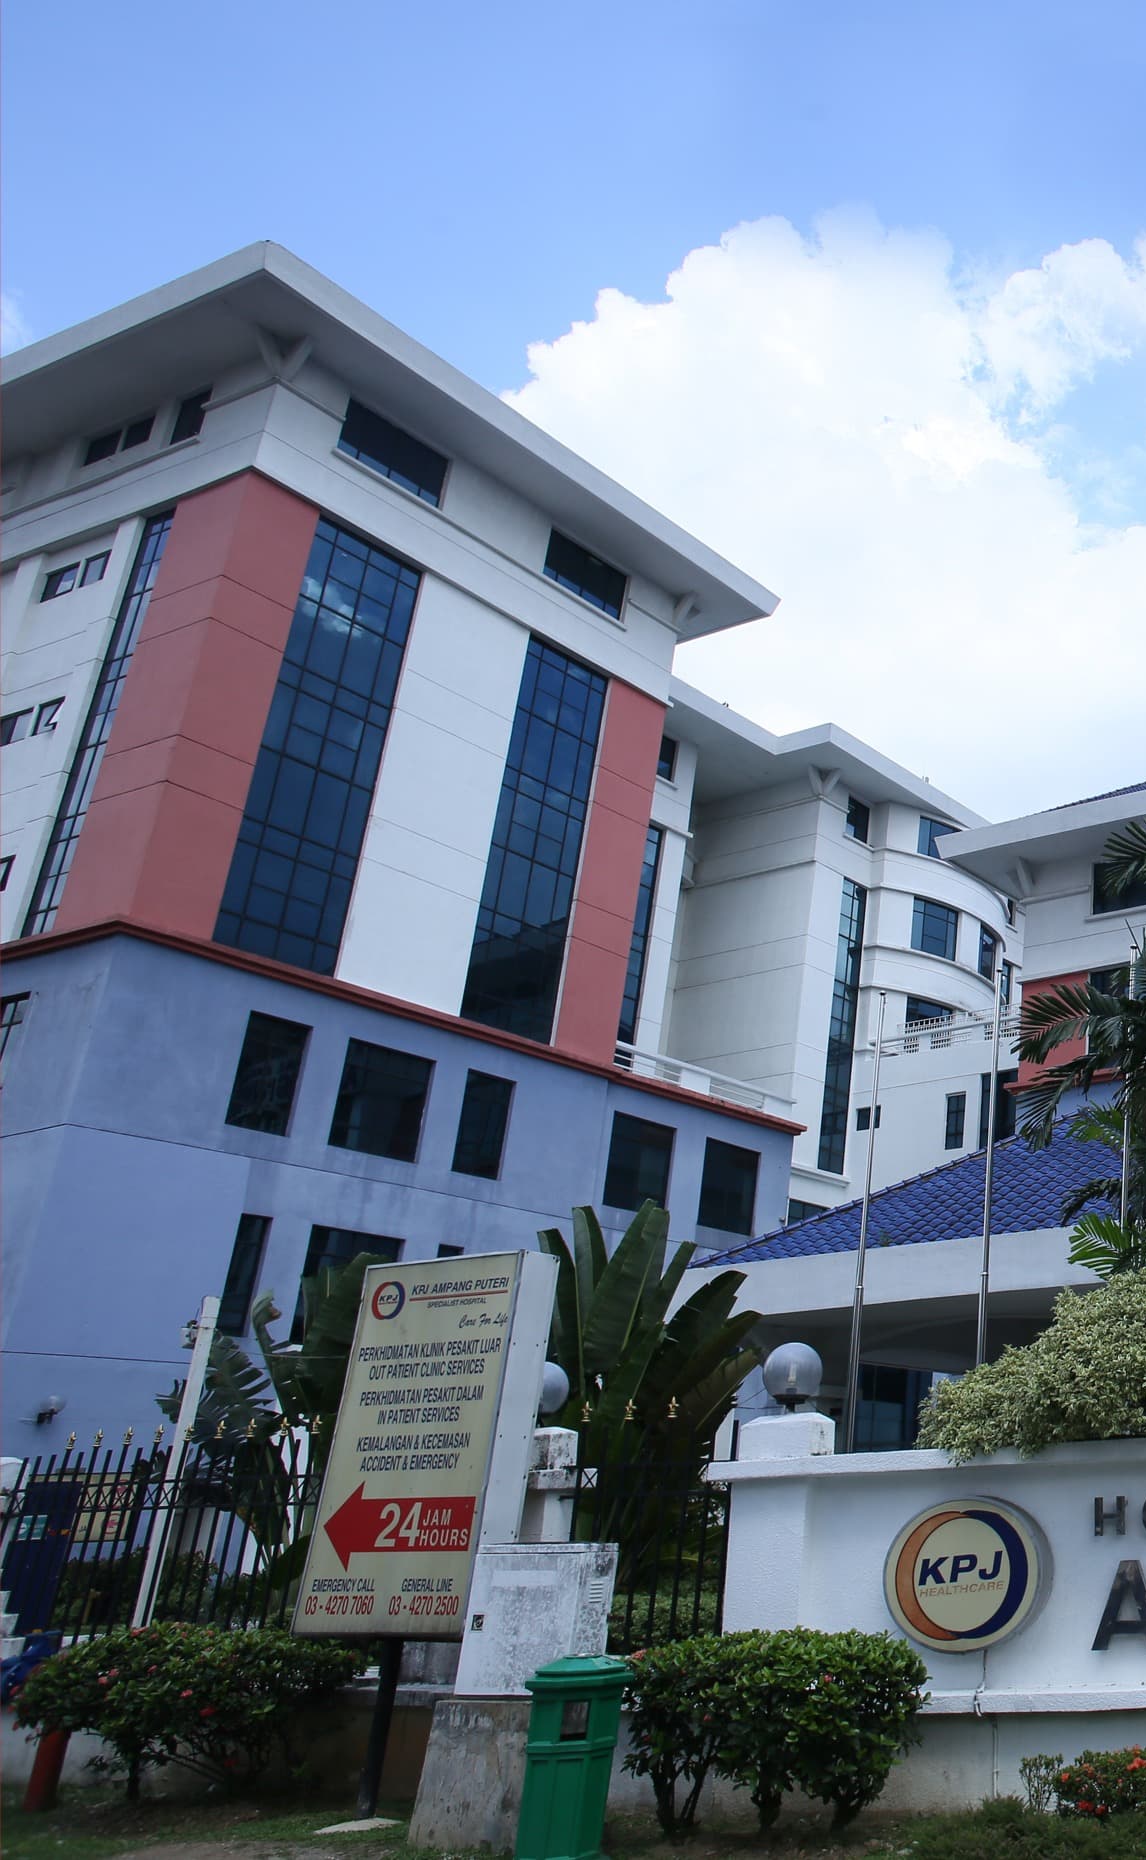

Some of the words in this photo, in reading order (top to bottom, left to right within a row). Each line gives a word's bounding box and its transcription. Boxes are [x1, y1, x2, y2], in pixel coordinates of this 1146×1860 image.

[431, 1280, 473, 1295] AMPANG
[474, 1277, 510, 1291] PUTERI
[379, 1294, 398, 1303] KPJ
[427, 1299, 460, 1308] SPECIALIST
[460, 1297, 487, 1306] HOSPITAL
[458, 1313, 477, 1328] Care
[478, 1312, 492, 1328] For
[493, 1311, 509, 1327] Life
[358, 1343, 420, 1361] PERKHIDMATAN
[420, 1341, 446, 1359] KLINIK
[446, 1339, 480, 1356] PESAKIT
[479, 1337, 502, 1354] LUAR
[369, 1365, 386, 1380] OUT
[386, 1362, 420, 1379] PATIENT
[420, 1360, 446, 1377] CLINIC
[446, 1358, 486, 1376] SERVICES
[359, 1388, 422, 1406] PERKHIDMATAN
[422, 1386, 456, 1403] PESAKIT
[456, 1384, 484, 1401] DALAM
[377, 1409, 387, 1425] IN
[387, 1408, 421, 1424] PATIENT
[421, 1406, 460, 1423] SERVICES
[356, 1434, 413, 1452] KEMALANGAN
[413, 1434, 419, 1450] &
[420, 1432, 471, 1450] KECEMASAN
[360, 1455, 402, 1472] ACCIDENT
[402, 1455, 409, 1470] &
[409, 1452, 460, 1470] EMERGENCY
[374, 1501, 423, 1547] 24
[422, 1508, 452, 1526] JAM
[419, 1528, 469, 1546] HOURS
[918, 1550, 1003, 1586] KPJ
[311, 1578, 357, 1592] EMERGENCY
[356, 1578, 375, 1592] CALL
[401, 1578, 435, 1592] GENERAL
[435, 1578, 454, 1592] LINE
[919, 1580, 1004, 1598] HEALTHCARE
[304, 1595, 318, 1615] 03
[325, 1595, 350, 1615] 4270
[350, 1595, 375, 1615] 7060
[388, 1595, 402, 1615] 03
[409, 1595, 434, 1615] 4270
[434, 1595, 460, 1615] 2500
